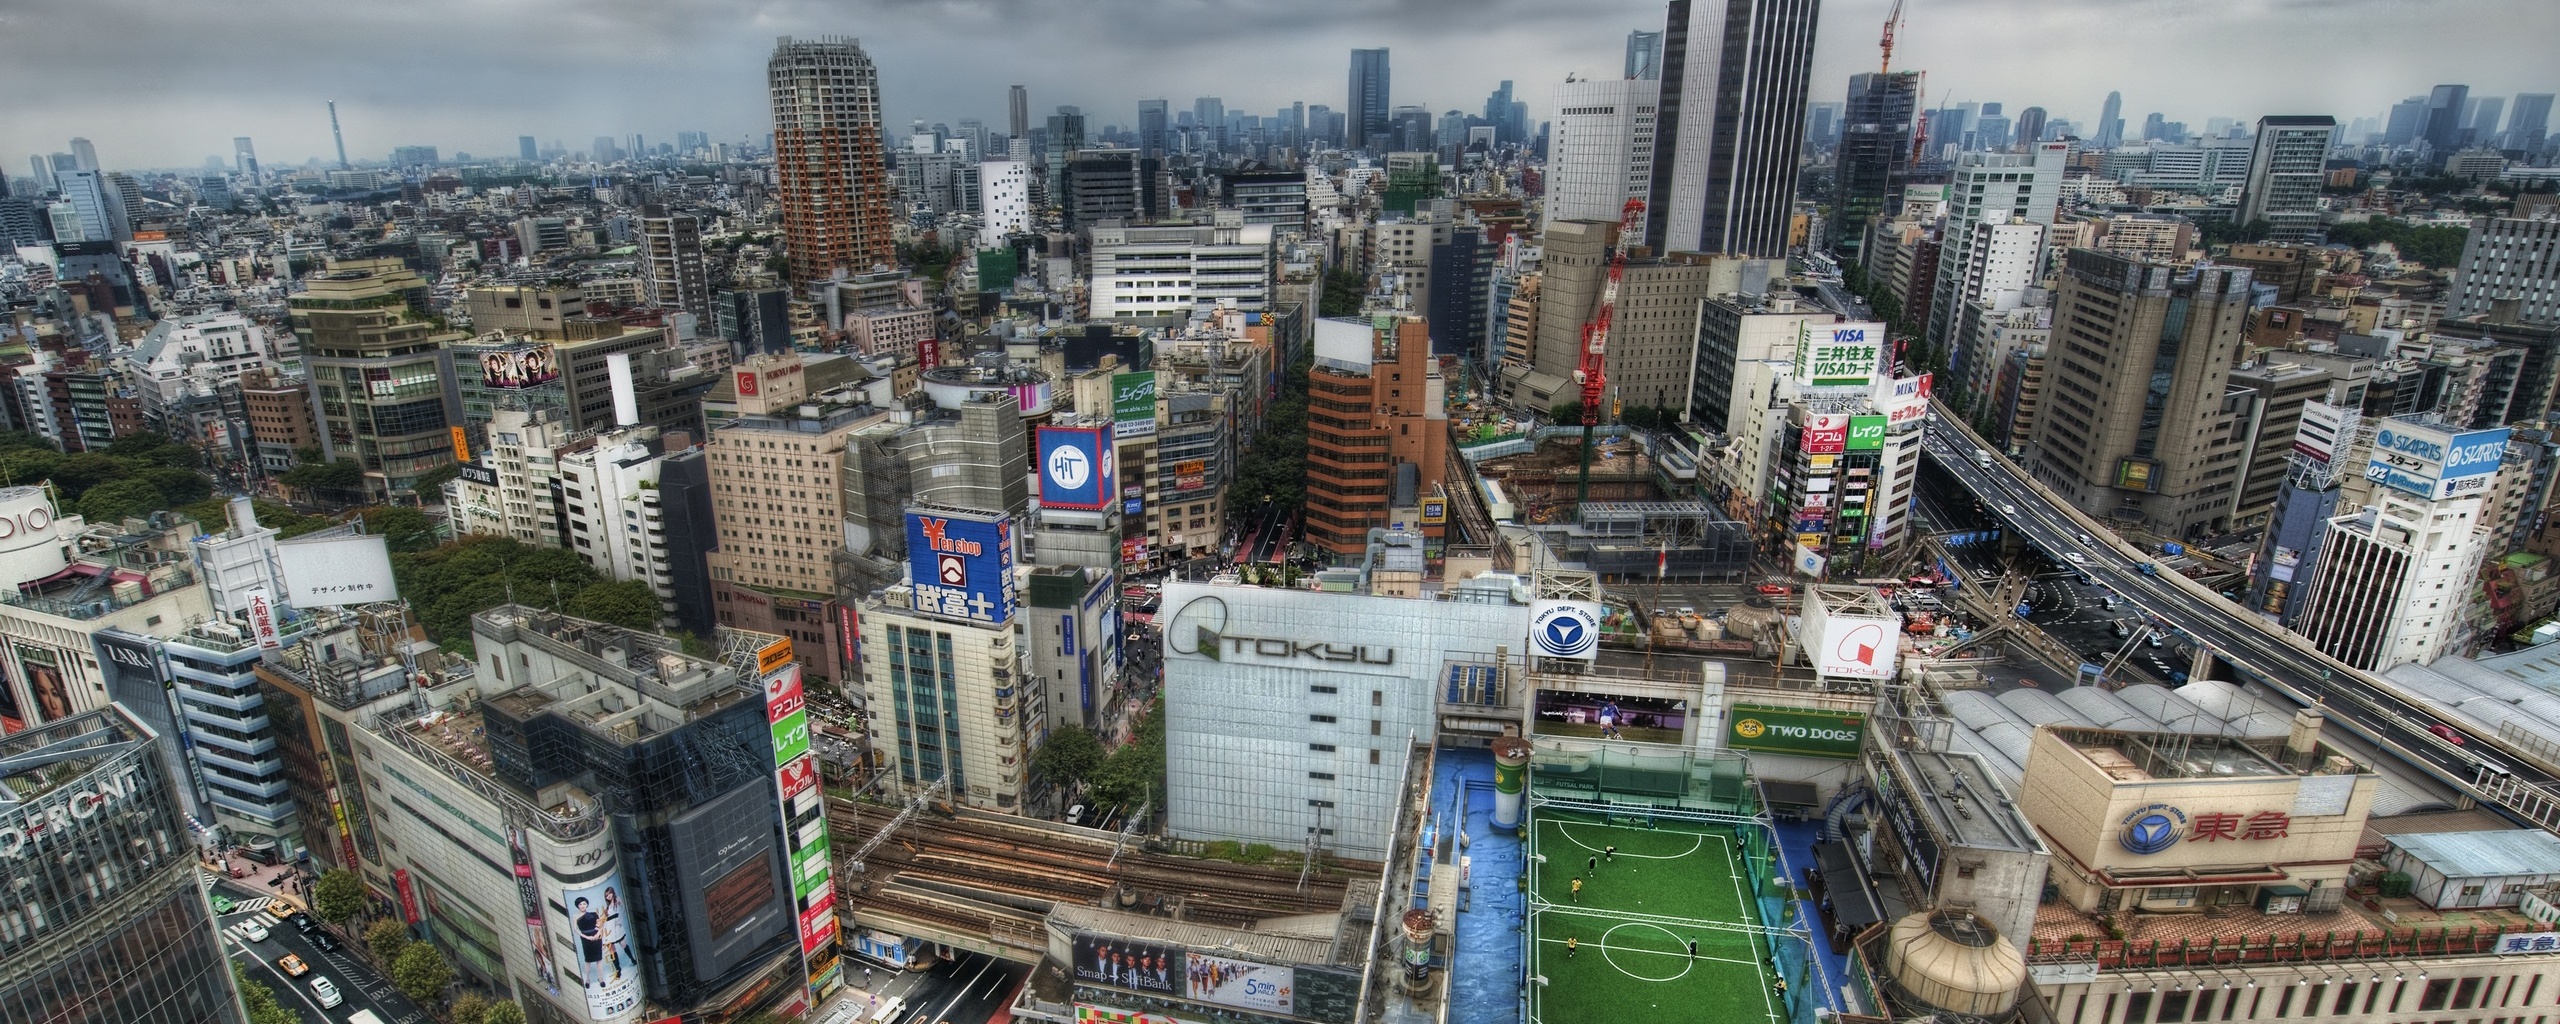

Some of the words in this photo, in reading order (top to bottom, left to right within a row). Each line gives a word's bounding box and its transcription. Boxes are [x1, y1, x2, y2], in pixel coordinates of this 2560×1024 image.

[1914, 190, 1940, 198] Manulife
[1832, 329, 1864, 342] VISA
[1815, 345, 1877, 361] 三井住友
[766, 366, 789, 380] TOKYU
[789, 363, 802, 375] INN
[1814, 362, 1875, 376] VISAカード
[1117, 382, 1155, 402] エイブル
[1895, 381, 1918, 397] MIKI
[1116, 404, 1154, 414] www.able.co.jp
[1813, 432, 1843, 442] アコム
[1852, 425, 1883, 438] レイク
[2393, 434, 2443, 462] STARTS
[2460, 441, 2504, 466] STARTS
[1055, 450, 1082, 480] HiT
[2386, 453, 2423, 471] スターツ
[2367, 465, 2389, 480] OZ
[955, 537, 982, 557] shop
[311, 583, 374, 595] デザイン制作中
[1001, 566, 1015, 620] 武富士
[915, 583, 995, 621] 武富士
[251, 595, 275, 639] 大和証券
[1535, 607, 1555, 625] TOKYU
[1557, 605, 1576, 613] DEPT.
[1578, 609, 1597, 628] STORE
[102, 643, 153, 669] ZARA
[763, 646, 792, 668] プロミス
[1221, 635, 1393, 666] TOKYU
[1823, 664, 1890, 677] TOKYU
[773, 694, 804, 719] アコム
[775, 722, 807, 753] レイク
[1766, 724, 1808, 738] TWO
[1808, 727, 1858, 742] DOGS
[784, 774, 813, 799] アイフル
[2121, 806, 2147, 826] TOKYU
[2169, 806, 2187, 825] STORE
[2187, 810, 2291, 843] 東急
[1894, 811, 1914, 856] FUTSAL
[1913, 847, 1930, 886] PARK
[792, 857, 803, 885] レイク
[802, 915, 811, 939] アコム
[814, 959, 834, 979] プロミス
[1077, 965, 1108, 982] Smap
[1121, 972, 1172, 992] SoftBank
[1244, 978, 1257, 995] 5
[1257, 981, 1277, 992] min.
[1257, 988, 1276, 996] WALK
